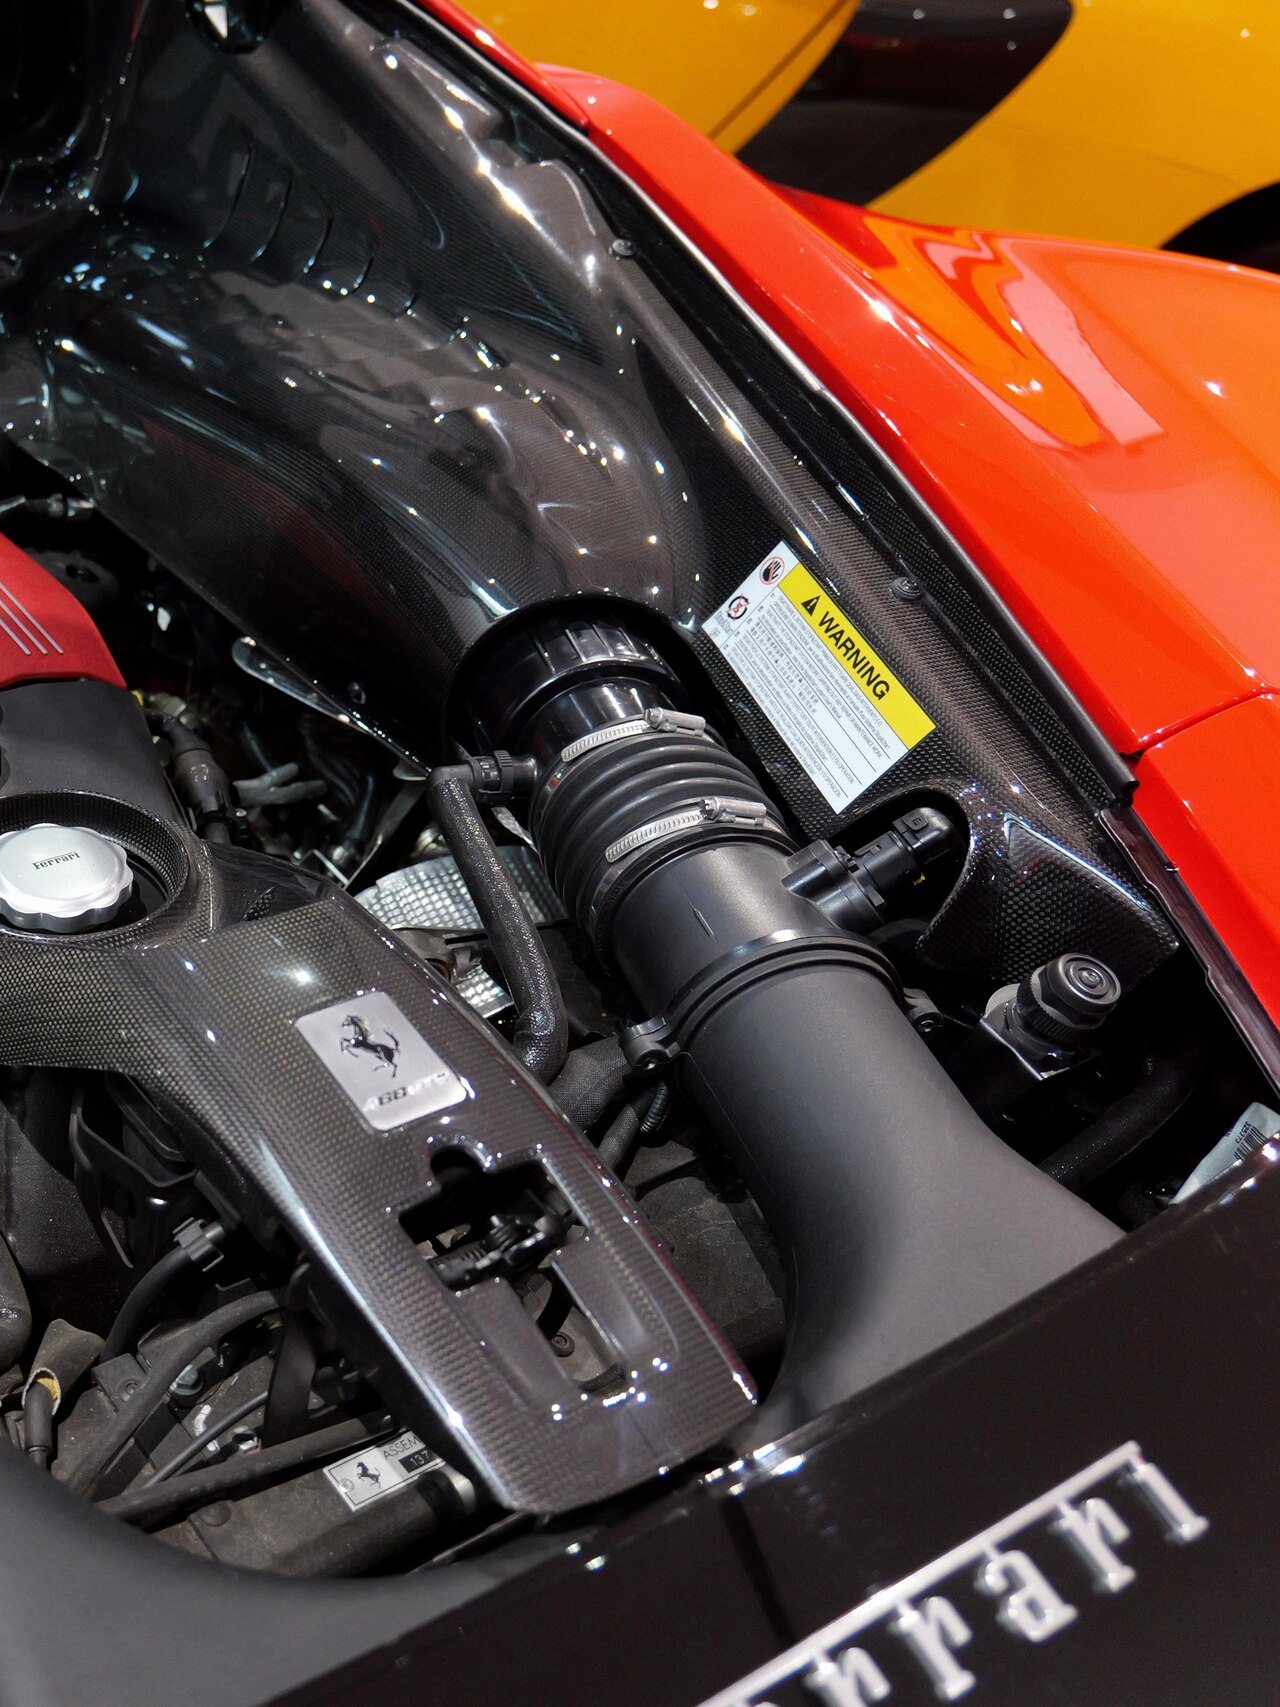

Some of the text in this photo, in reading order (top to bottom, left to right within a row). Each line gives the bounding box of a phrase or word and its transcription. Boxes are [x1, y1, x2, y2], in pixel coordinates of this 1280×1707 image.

[818, 611, 890, 701] WARNING
[32, 851, 80, 870] Ferrari
[383, 1435, 422, 1460] ASSEM
[696, 1440, 1210, 1707] rrari
